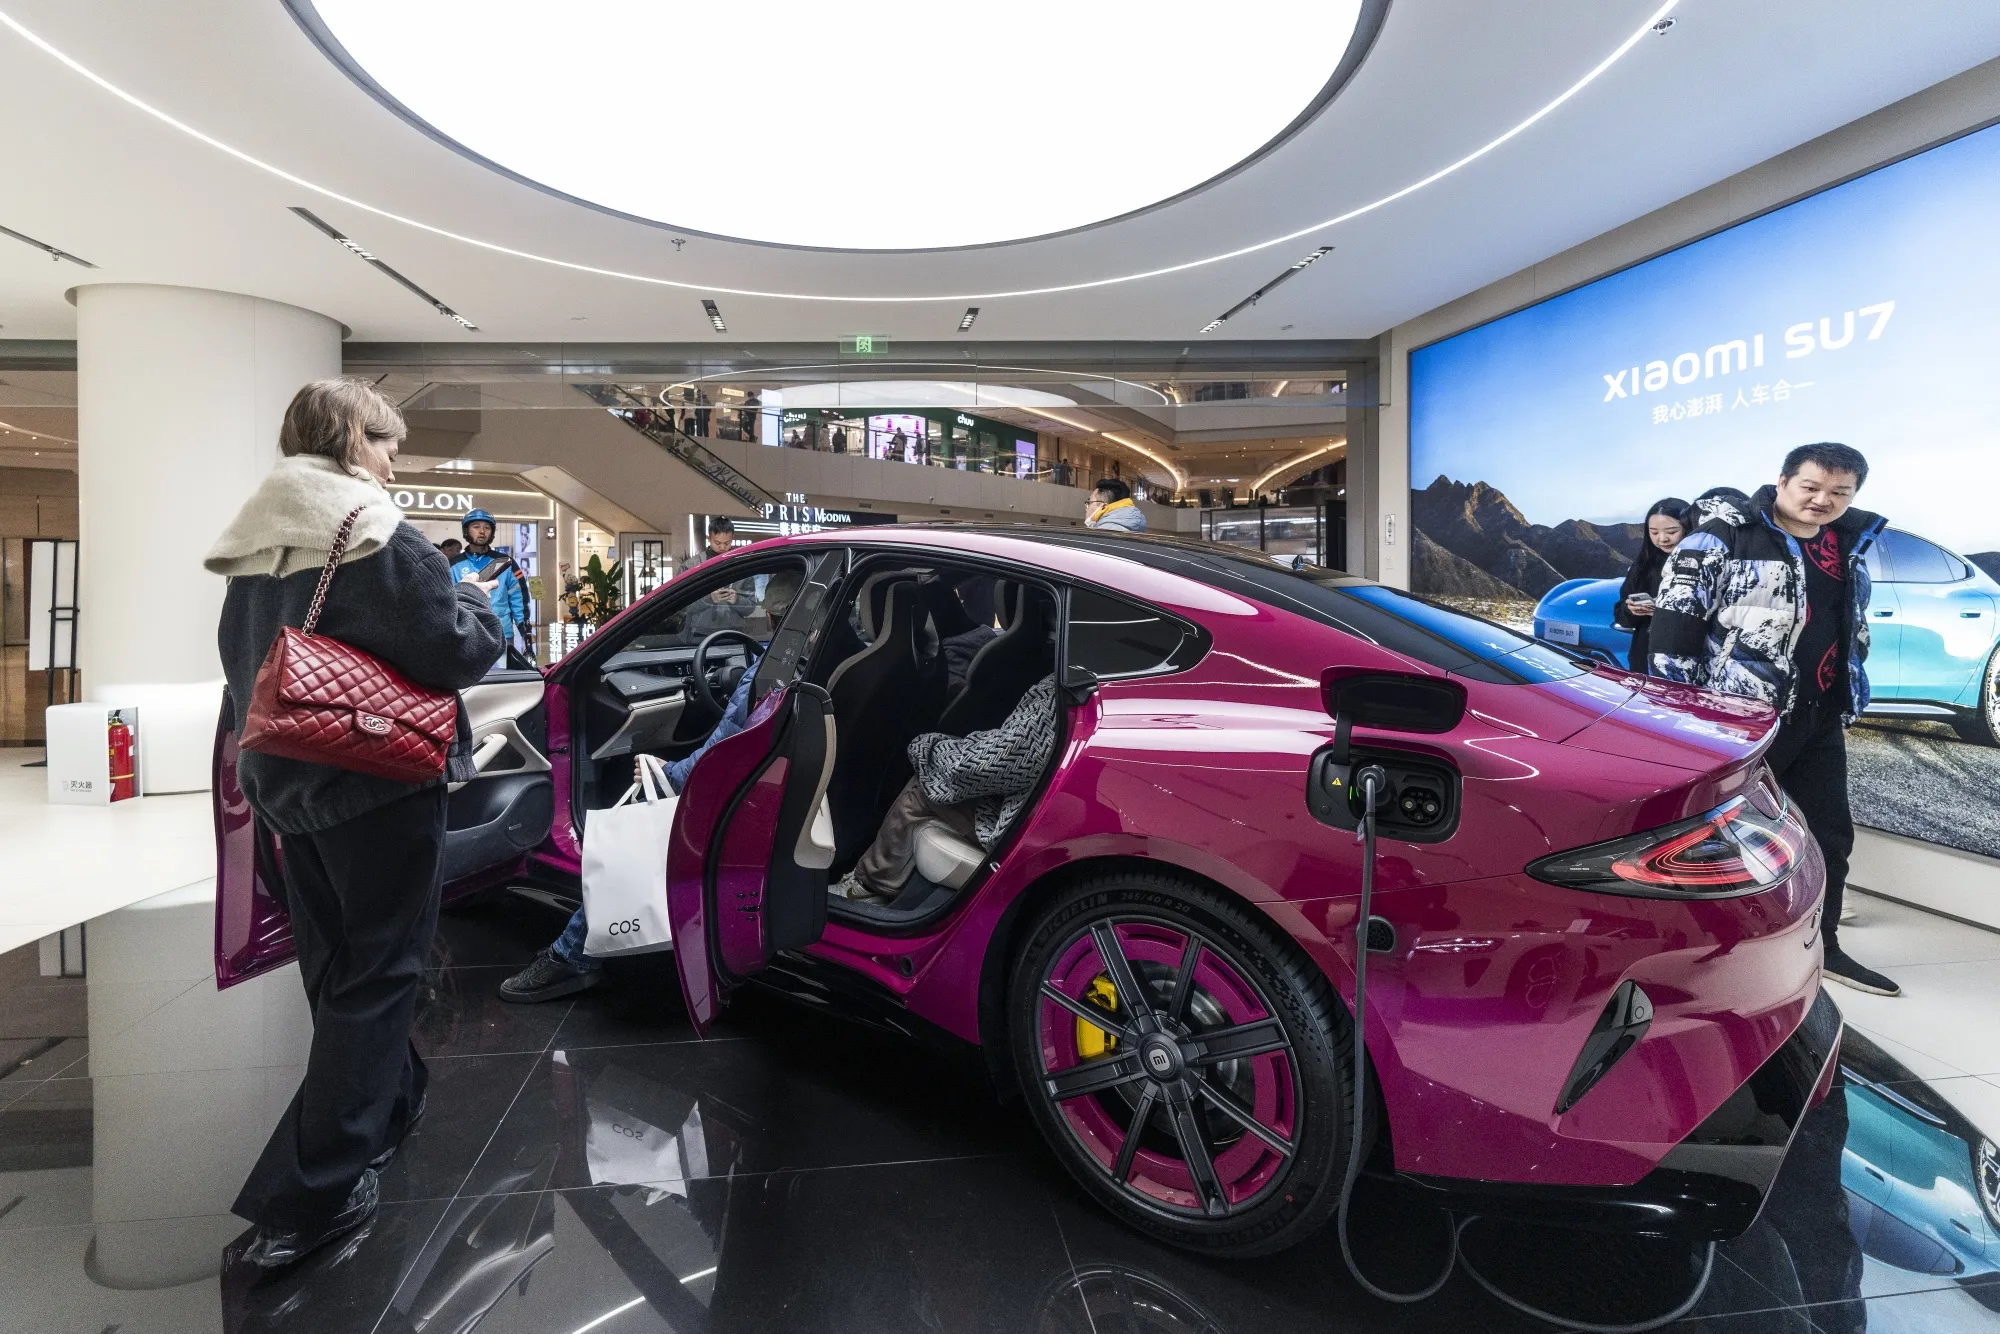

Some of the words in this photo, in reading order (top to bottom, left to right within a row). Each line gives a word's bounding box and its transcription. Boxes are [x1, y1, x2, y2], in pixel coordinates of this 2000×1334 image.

[1785, 300, 1896, 359] SU7
[1652, 392, 1724, 425] 我心澎湃
[1731, 378, 1816, 410] 人车合一
[957, 414, 974, 427] chuu
[786, 492, 806, 504] THE
[764, 503, 825, 523] PRISM
[608, 918, 641, 936] COS
